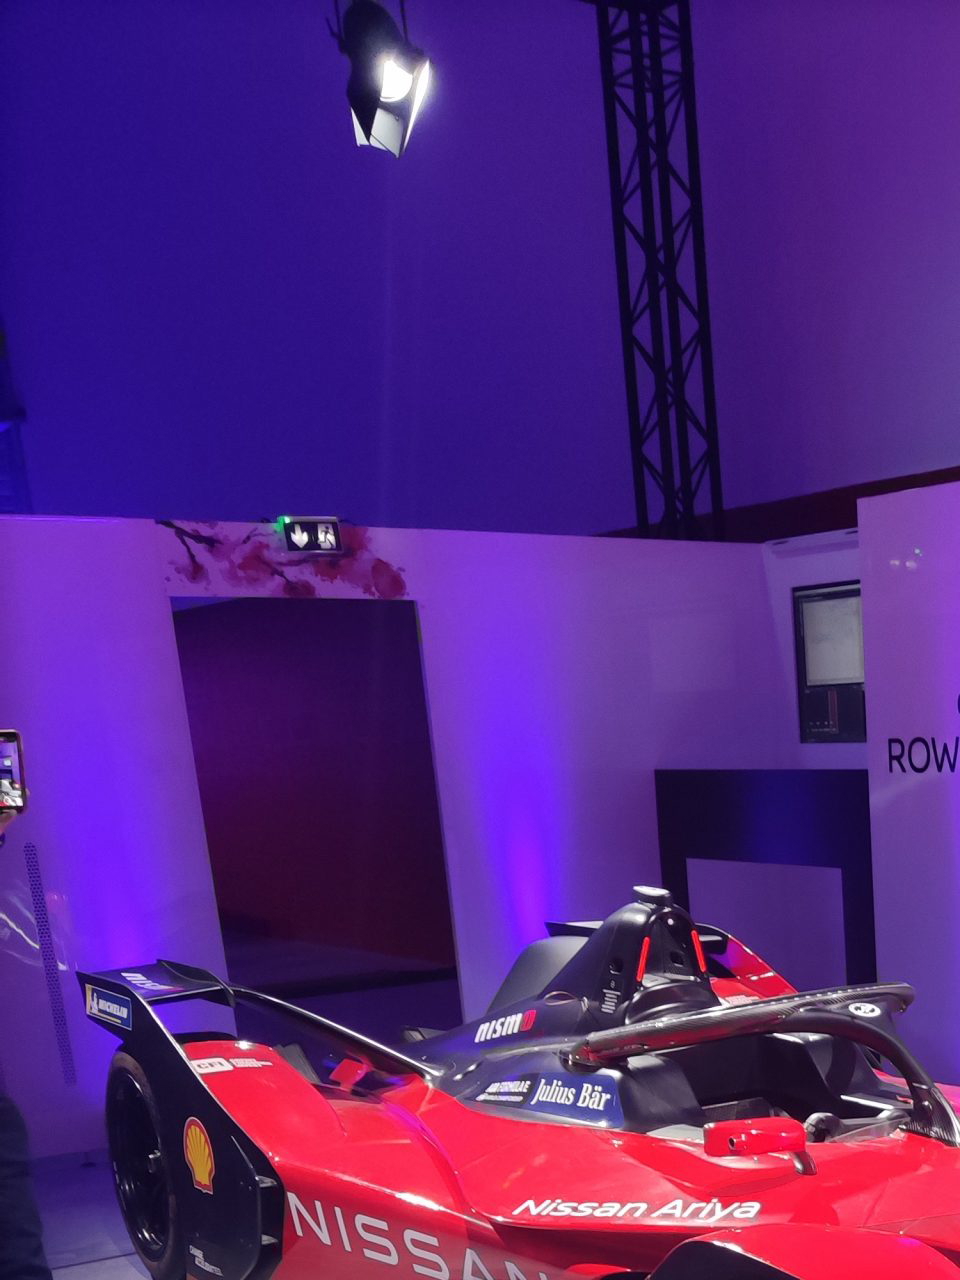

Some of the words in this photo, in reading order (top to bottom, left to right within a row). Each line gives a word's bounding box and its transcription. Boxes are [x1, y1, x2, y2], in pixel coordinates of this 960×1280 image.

[530, 1078, 576, 1105] Julius
[576, 1082, 611, 1110] Bär
[512, 1199, 648, 1217] Nissan
[651, 1198, 761, 1222] Ariya
